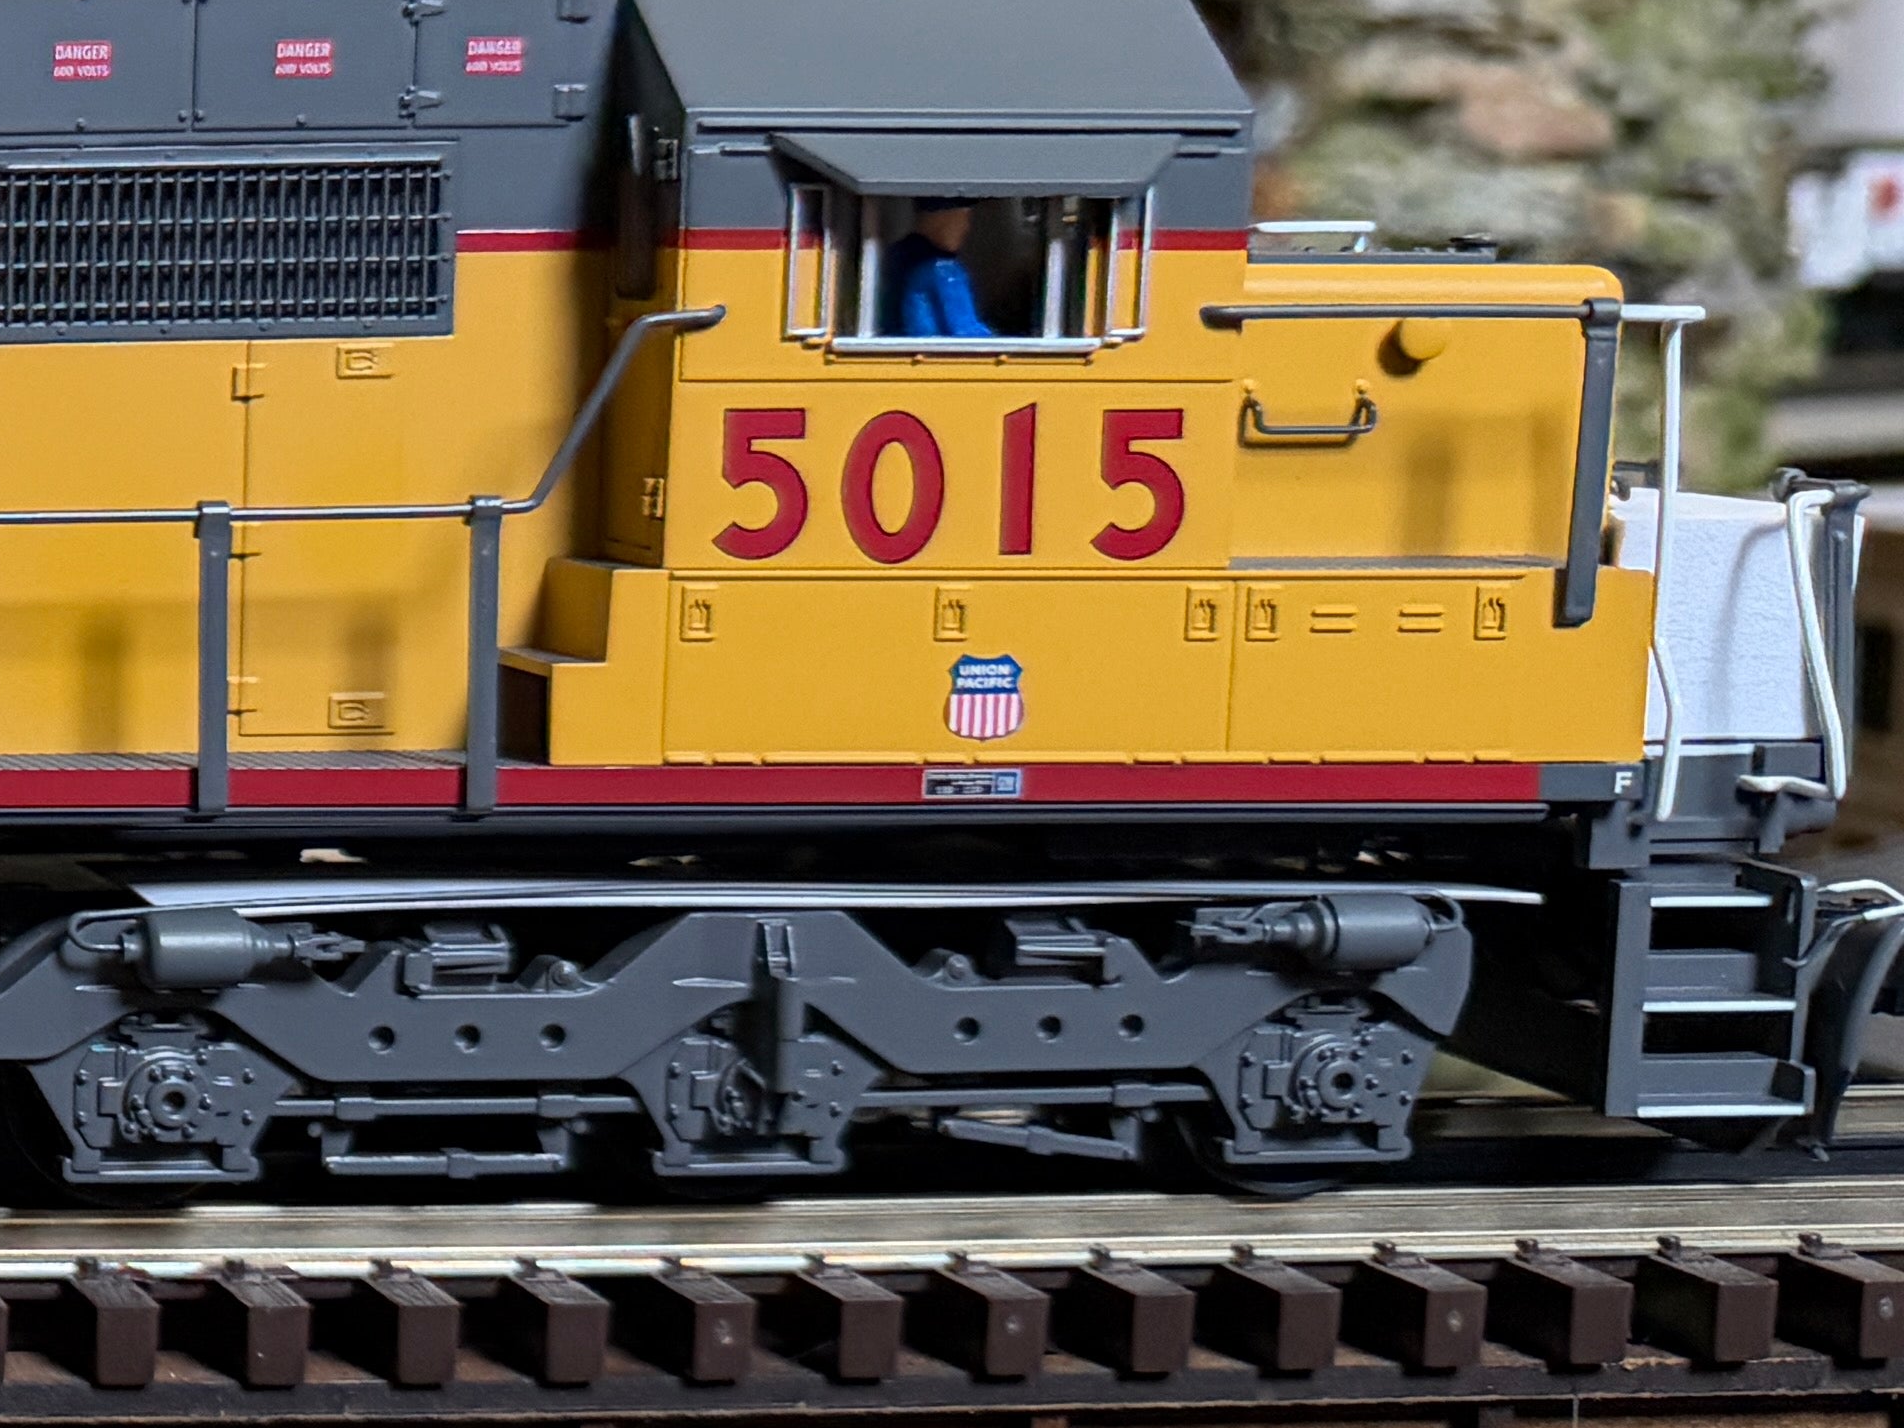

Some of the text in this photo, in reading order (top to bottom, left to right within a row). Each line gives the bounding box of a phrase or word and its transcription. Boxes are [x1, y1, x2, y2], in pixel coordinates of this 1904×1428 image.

[55, 44, 109, 60] DANGER
[277, 42, 330, 58] DANGER
[468, 40, 522, 55] DANGER
[77, 65, 110, 77] VOLTS
[711, 401, 1185, 564] 5015
[958, 663, 1010, 675] UNION
[956, 677, 1014, 688] PACIFIC
[1614, 771, 1633, 794] F
